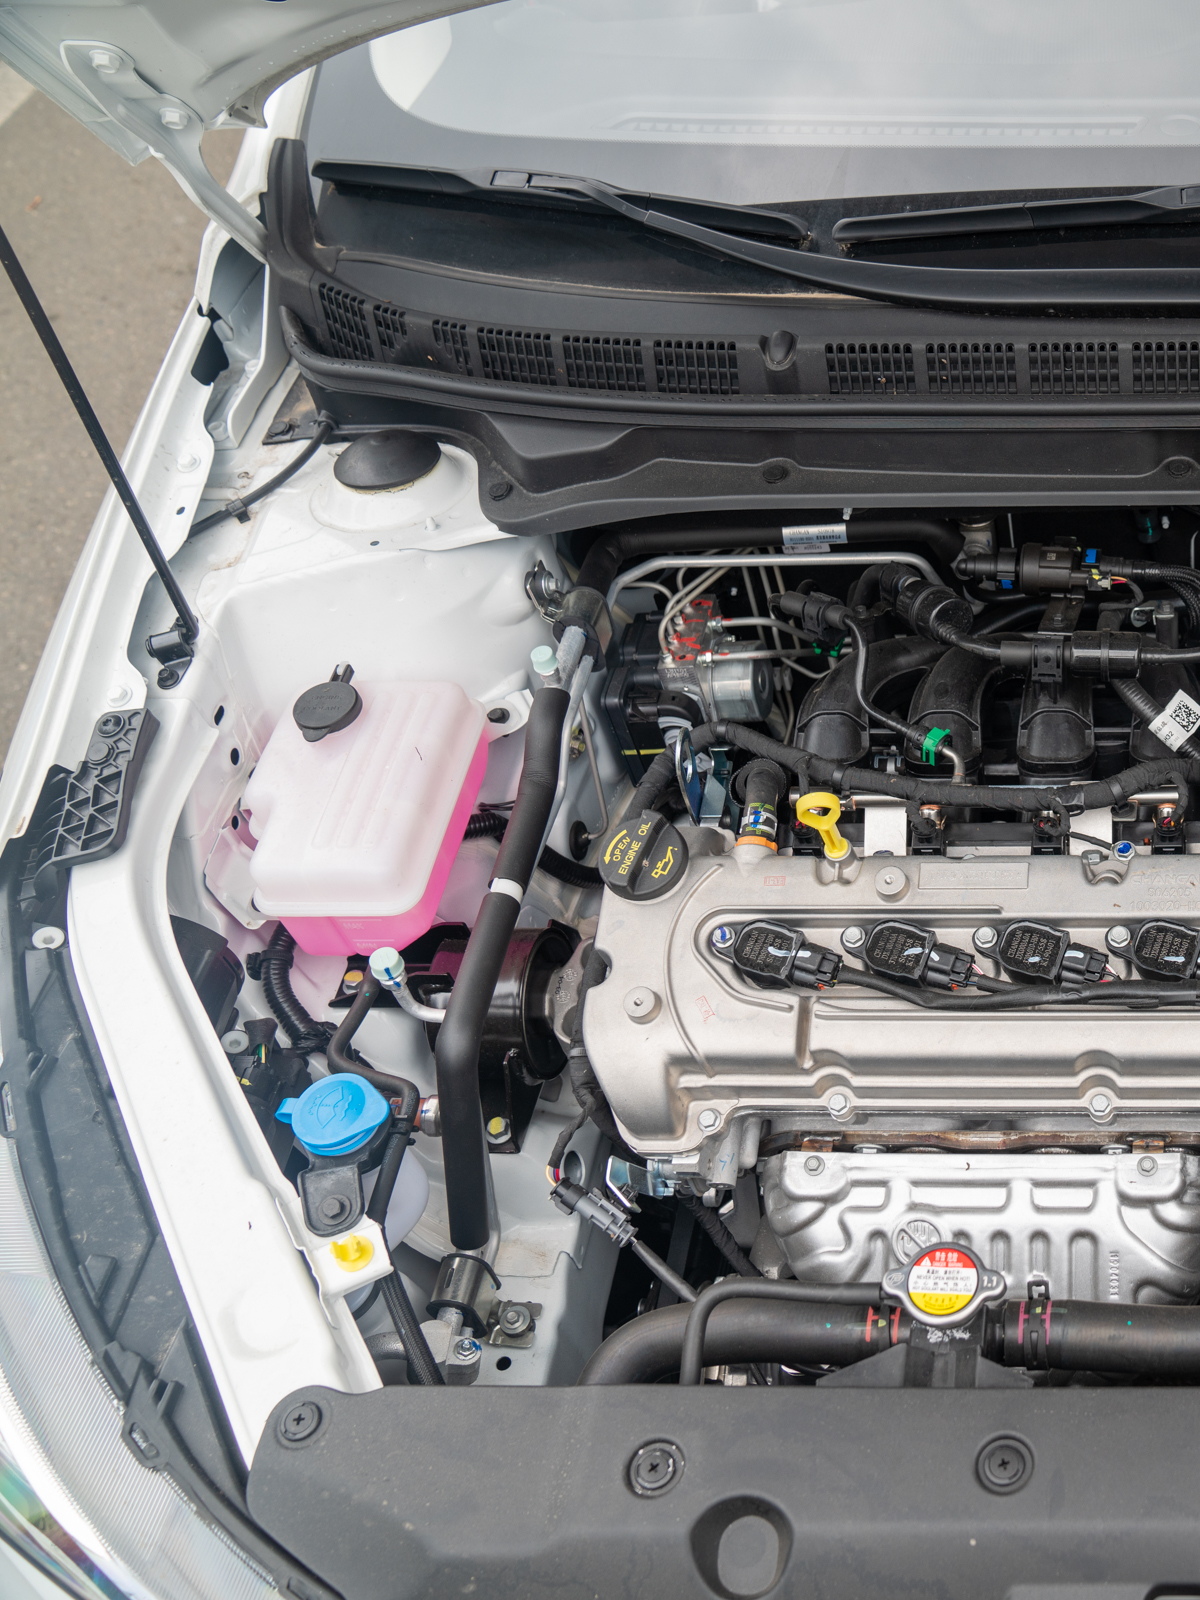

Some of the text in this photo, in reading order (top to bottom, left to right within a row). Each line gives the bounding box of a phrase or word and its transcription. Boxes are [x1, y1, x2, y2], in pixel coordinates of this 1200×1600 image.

[612, 836, 630, 862] OPEN
[618, 822, 652, 875] ENGINE OIL
[742, 930, 759, 958] CHANGAN
[874, 930, 890, 958] CHANGAN
[1008, 930, 1023, 958] CHANGAN
[1142, 928, 1157, 958] CHANGAN
[982, 1276, 997, 1288] 1.1
